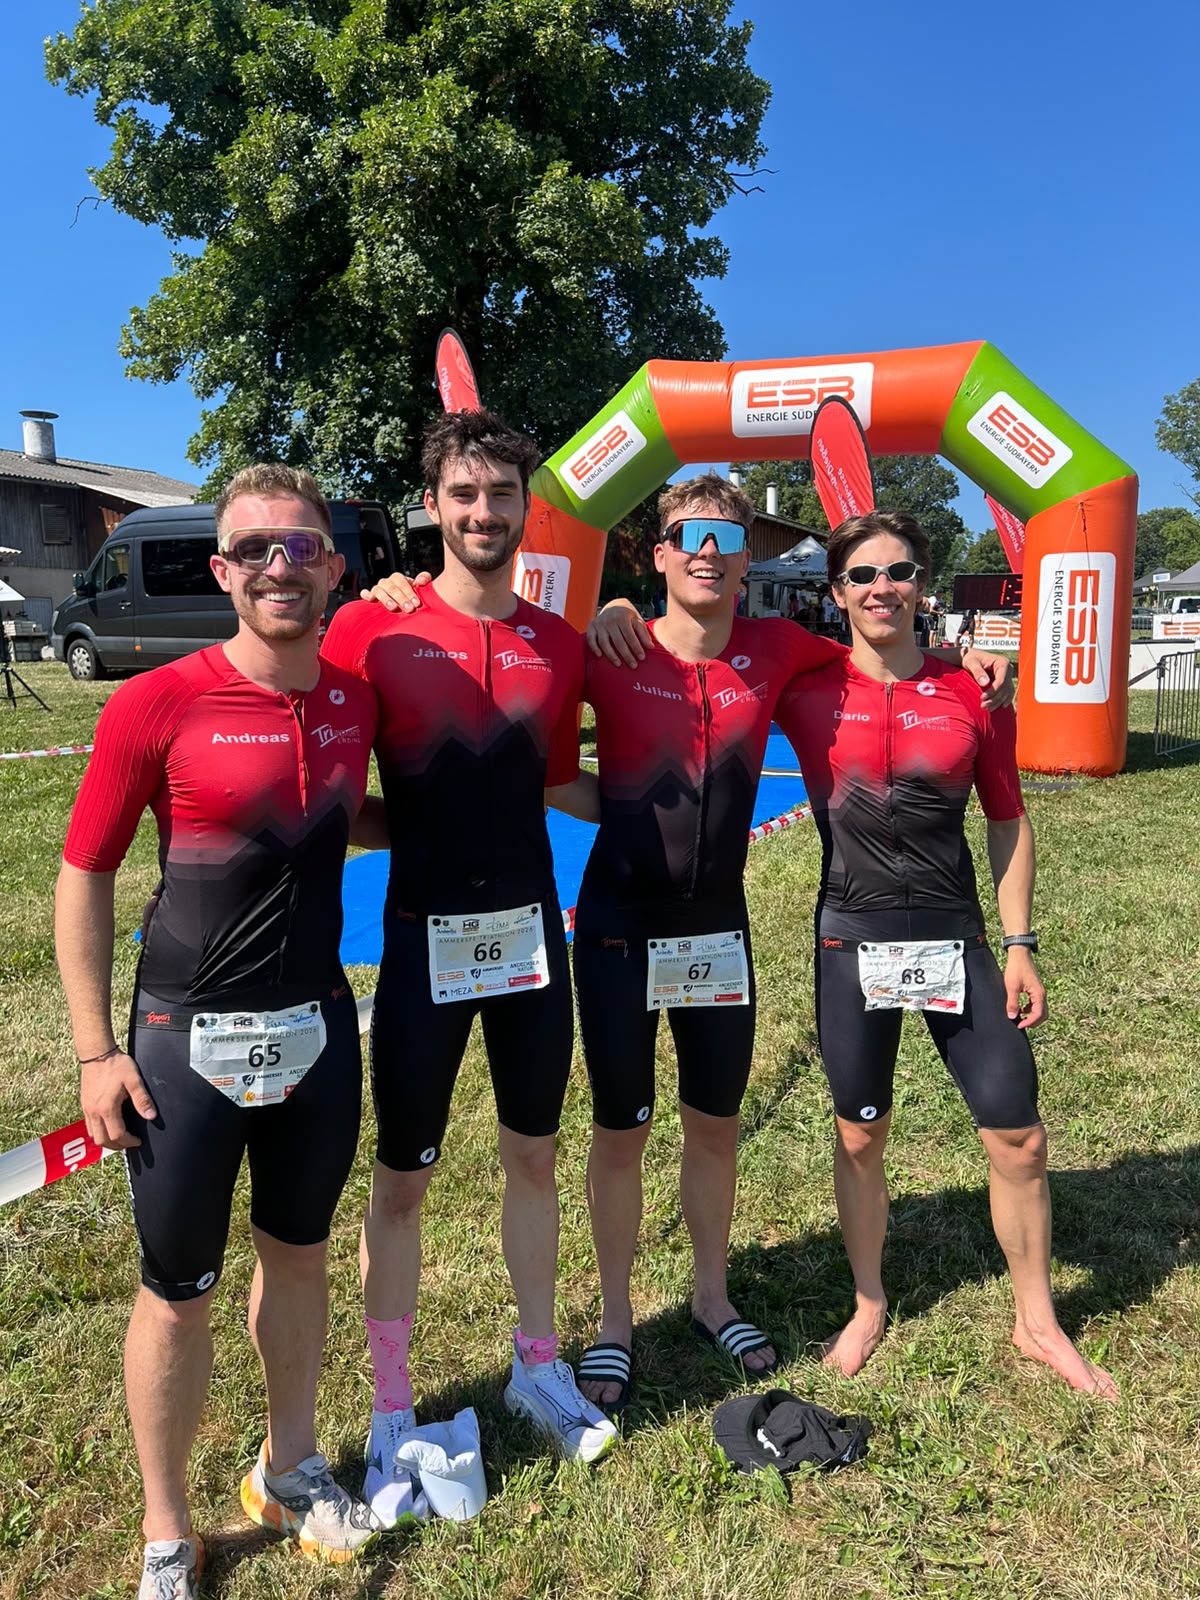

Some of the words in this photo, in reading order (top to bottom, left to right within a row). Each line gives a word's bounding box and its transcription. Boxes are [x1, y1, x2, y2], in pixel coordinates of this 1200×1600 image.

[747, 376, 855, 408] ESB
[747, 411, 789, 423] ENERGIE
[979, 421, 1006, 445] ENERGIE
[987, 404, 1056, 467] ESB
[570, 424, 628, 481] ESB
[581, 466, 604, 488] ENERGIE
[1053, 570, 1065, 616] ENERGIE
[1064, 569, 1100, 686] ESB
[1164, 621, 1200, 636] ES
[413, 648, 469, 660] János
[1050, 620, 1063, 685] SÜDBAYERN
[633, 682, 682, 701] Julian
[834, 711, 870, 722] Dario
[212, 733, 290, 744] Andreas
[480, 931, 515, 941] TRIATHLON
[474, 941, 502, 962] 66
[437, 970, 465, 982] ESB
[688, 962, 712, 980] 67
[902, 968, 926, 985] 68
[451, 986, 473, 996] MEZA
[233, 1017, 253, 1027] HG
[248, 1042, 281, 1068] 65
[207, 1076, 235, 1087] SB
